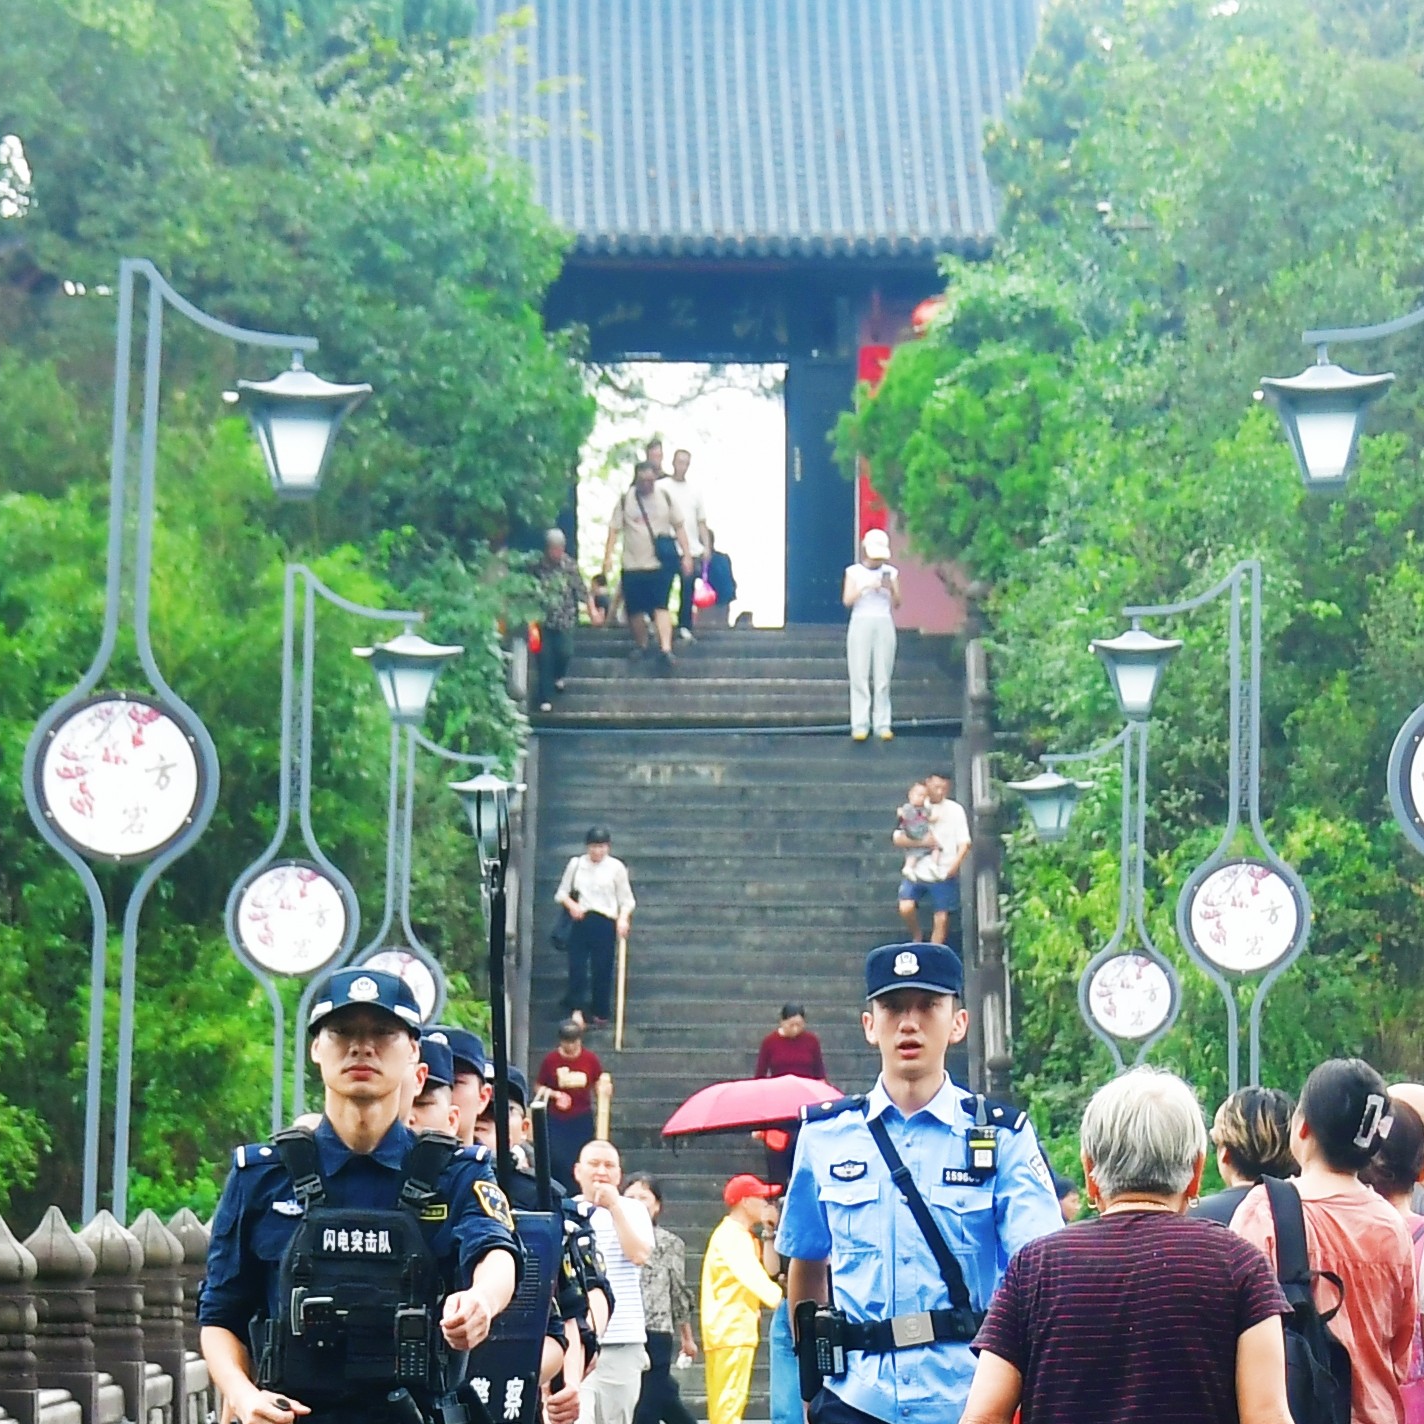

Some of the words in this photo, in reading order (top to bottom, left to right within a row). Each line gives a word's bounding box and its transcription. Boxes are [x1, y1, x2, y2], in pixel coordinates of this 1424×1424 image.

[322, 1228, 392, 1254] 闪电突击队
